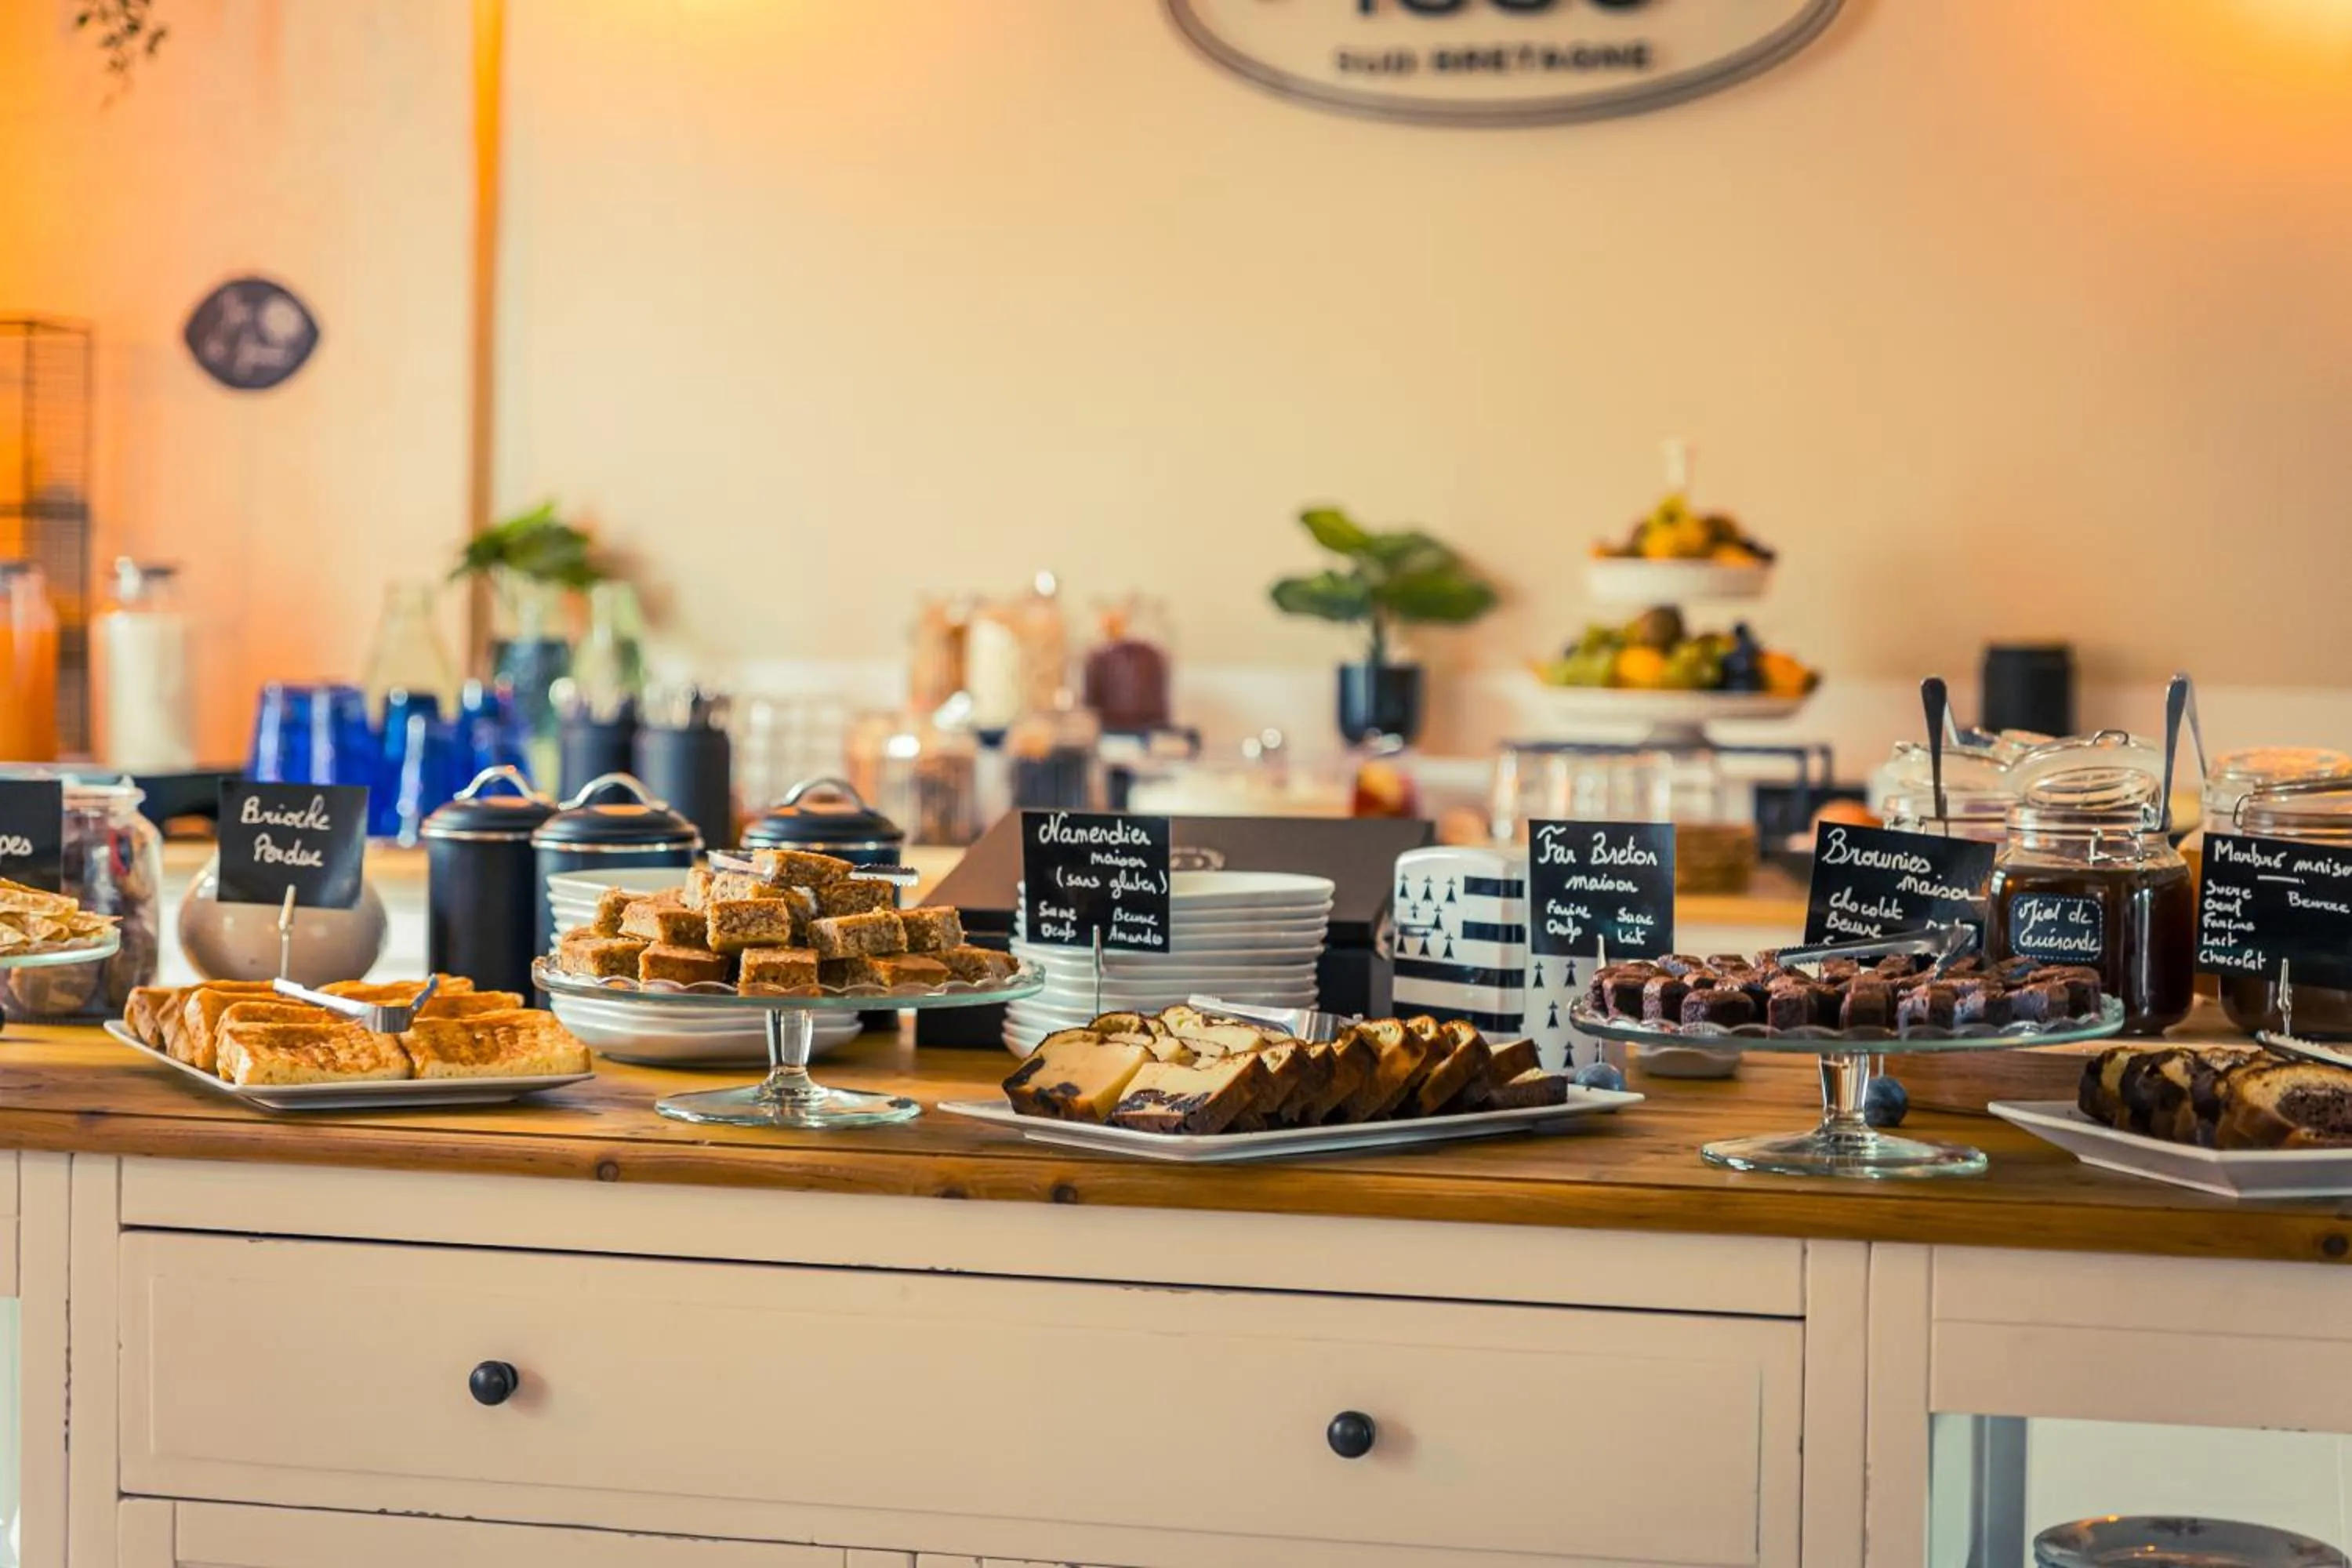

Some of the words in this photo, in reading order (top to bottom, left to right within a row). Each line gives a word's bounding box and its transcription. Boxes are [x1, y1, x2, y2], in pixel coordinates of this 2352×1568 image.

[241, 793, 331, 830] Brioche
[253, 833, 324, 868] Perdue
[1537, 824, 1577, 864] Far
[1590, 831, 1658, 866] Breton
[1821, 828, 1931, 873] Brownies
[1091, 849, 1148, 869] maison
[1056, 866, 1101, 887] (sans
[1565, 873, 1639, 893] maison
[1896, 874, 1987, 902] maison
[2205, 879, 2252, 900] Sucre
[1826, 912, 1882, 938] Beurre
[2018, 898, 2062, 929] Miel
[2068, 900, 2094, 924] de
[1617, 926, 1647, 946] Lait
[2019, 927, 2102, 952] Guérande
[2202, 931, 2238, 947] Lait
[2198, 949, 2267, 971] Chocolat
